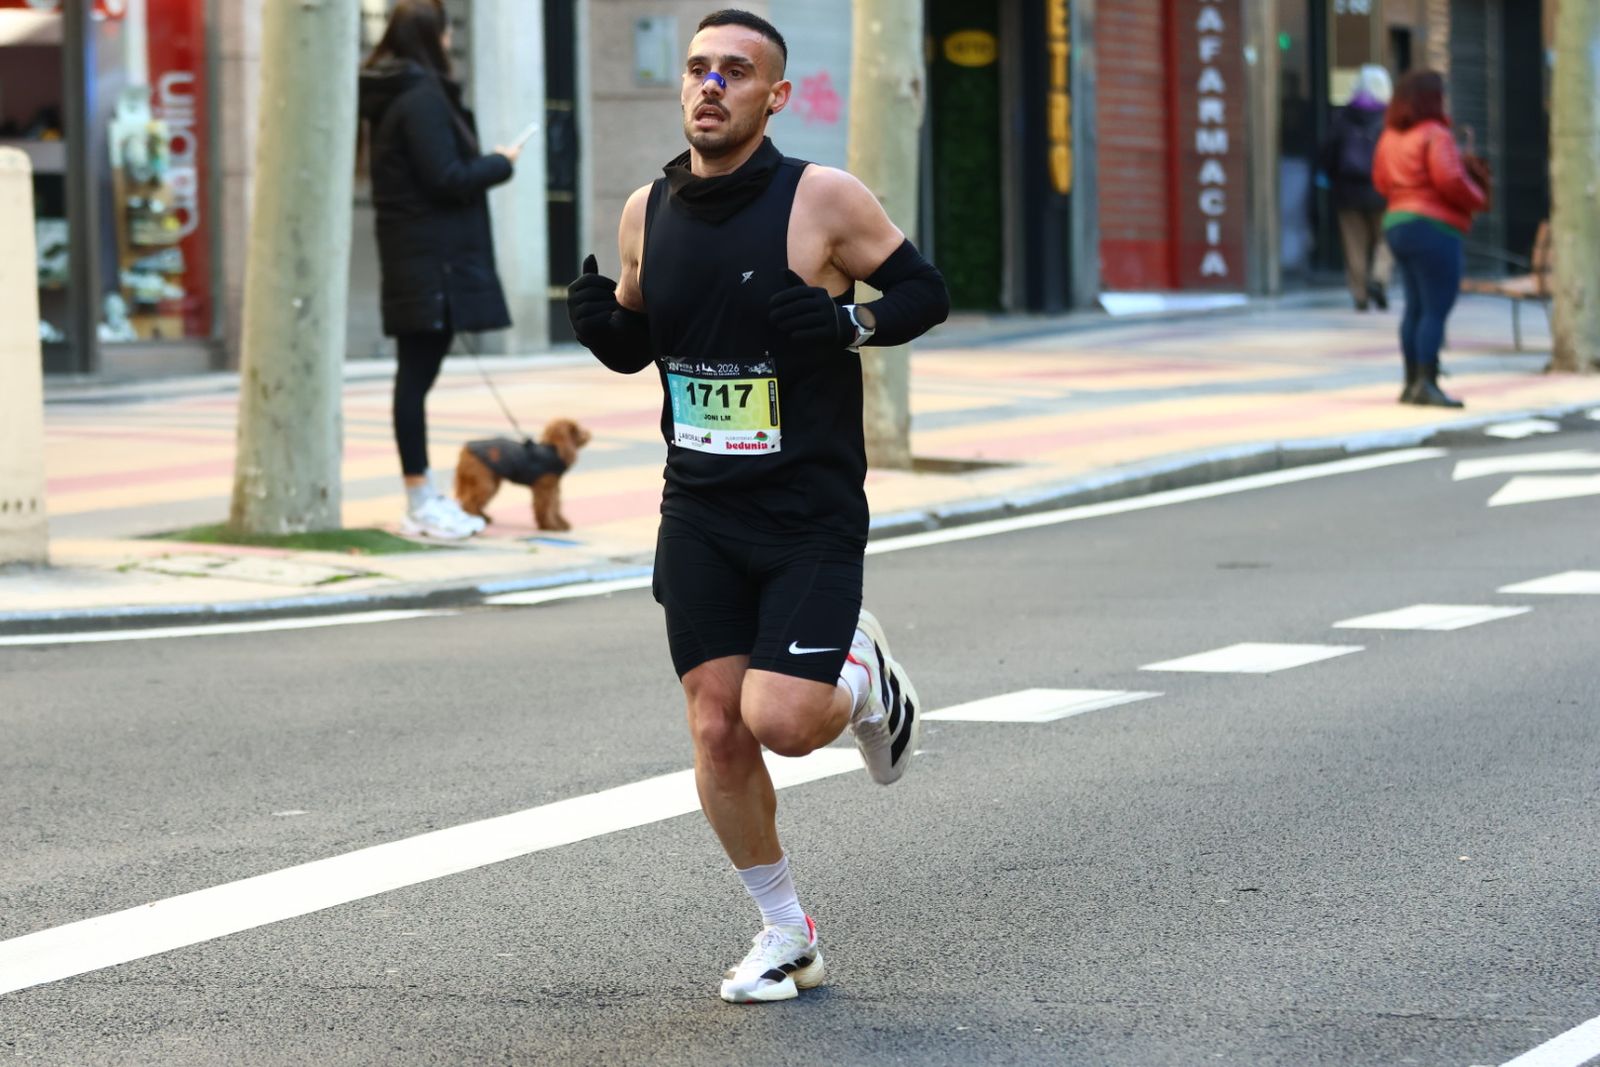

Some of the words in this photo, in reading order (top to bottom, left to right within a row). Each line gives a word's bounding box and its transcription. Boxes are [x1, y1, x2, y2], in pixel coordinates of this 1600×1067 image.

[1196, 0, 1228, 277] AFARMACIA
[717, 364, 740, 373] 2026
[686, 382, 753, 408] 1717
[678, 432, 701, 442] LABORAL
[725, 441, 768, 449] bedunia
